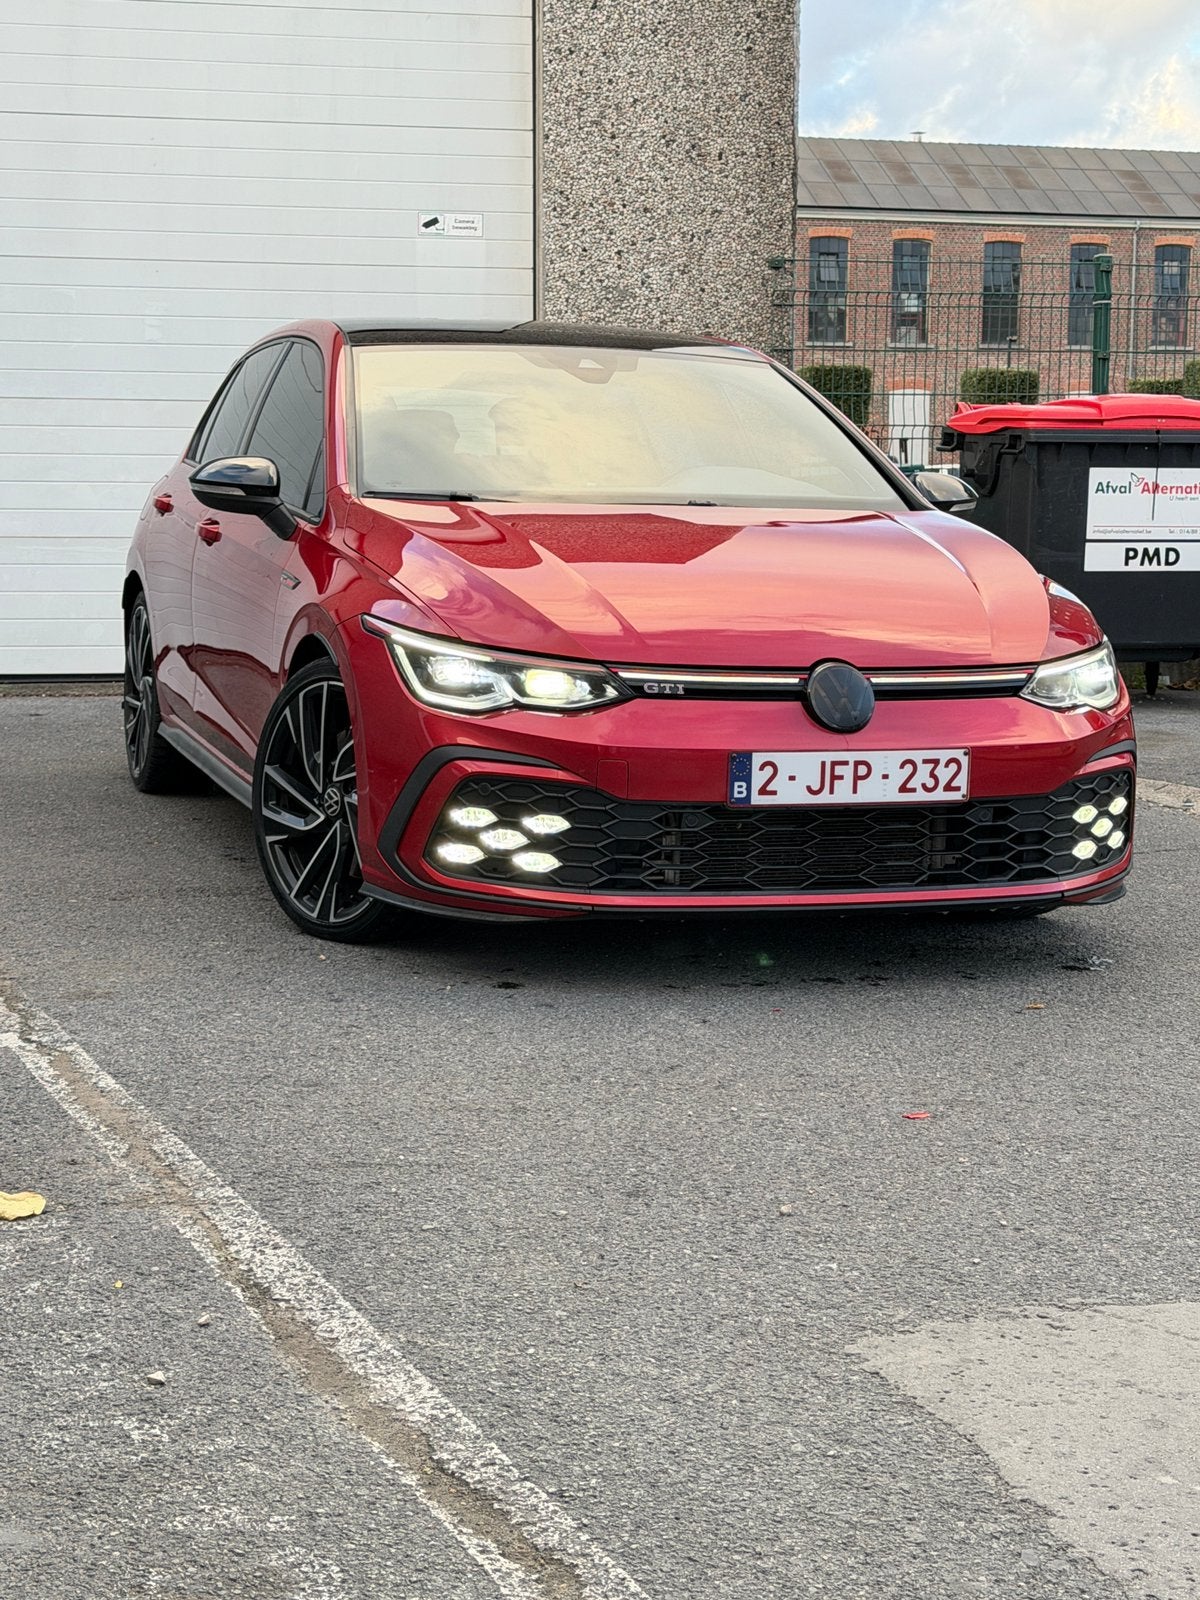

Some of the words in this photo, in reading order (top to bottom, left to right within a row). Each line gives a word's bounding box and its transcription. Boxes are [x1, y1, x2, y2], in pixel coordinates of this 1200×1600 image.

[1095, 481, 1132, 494] Afval
[1124, 547, 1180, 567] PMD
[643, 682, 685, 694] GTI
[733, 781, 747, 798] B
